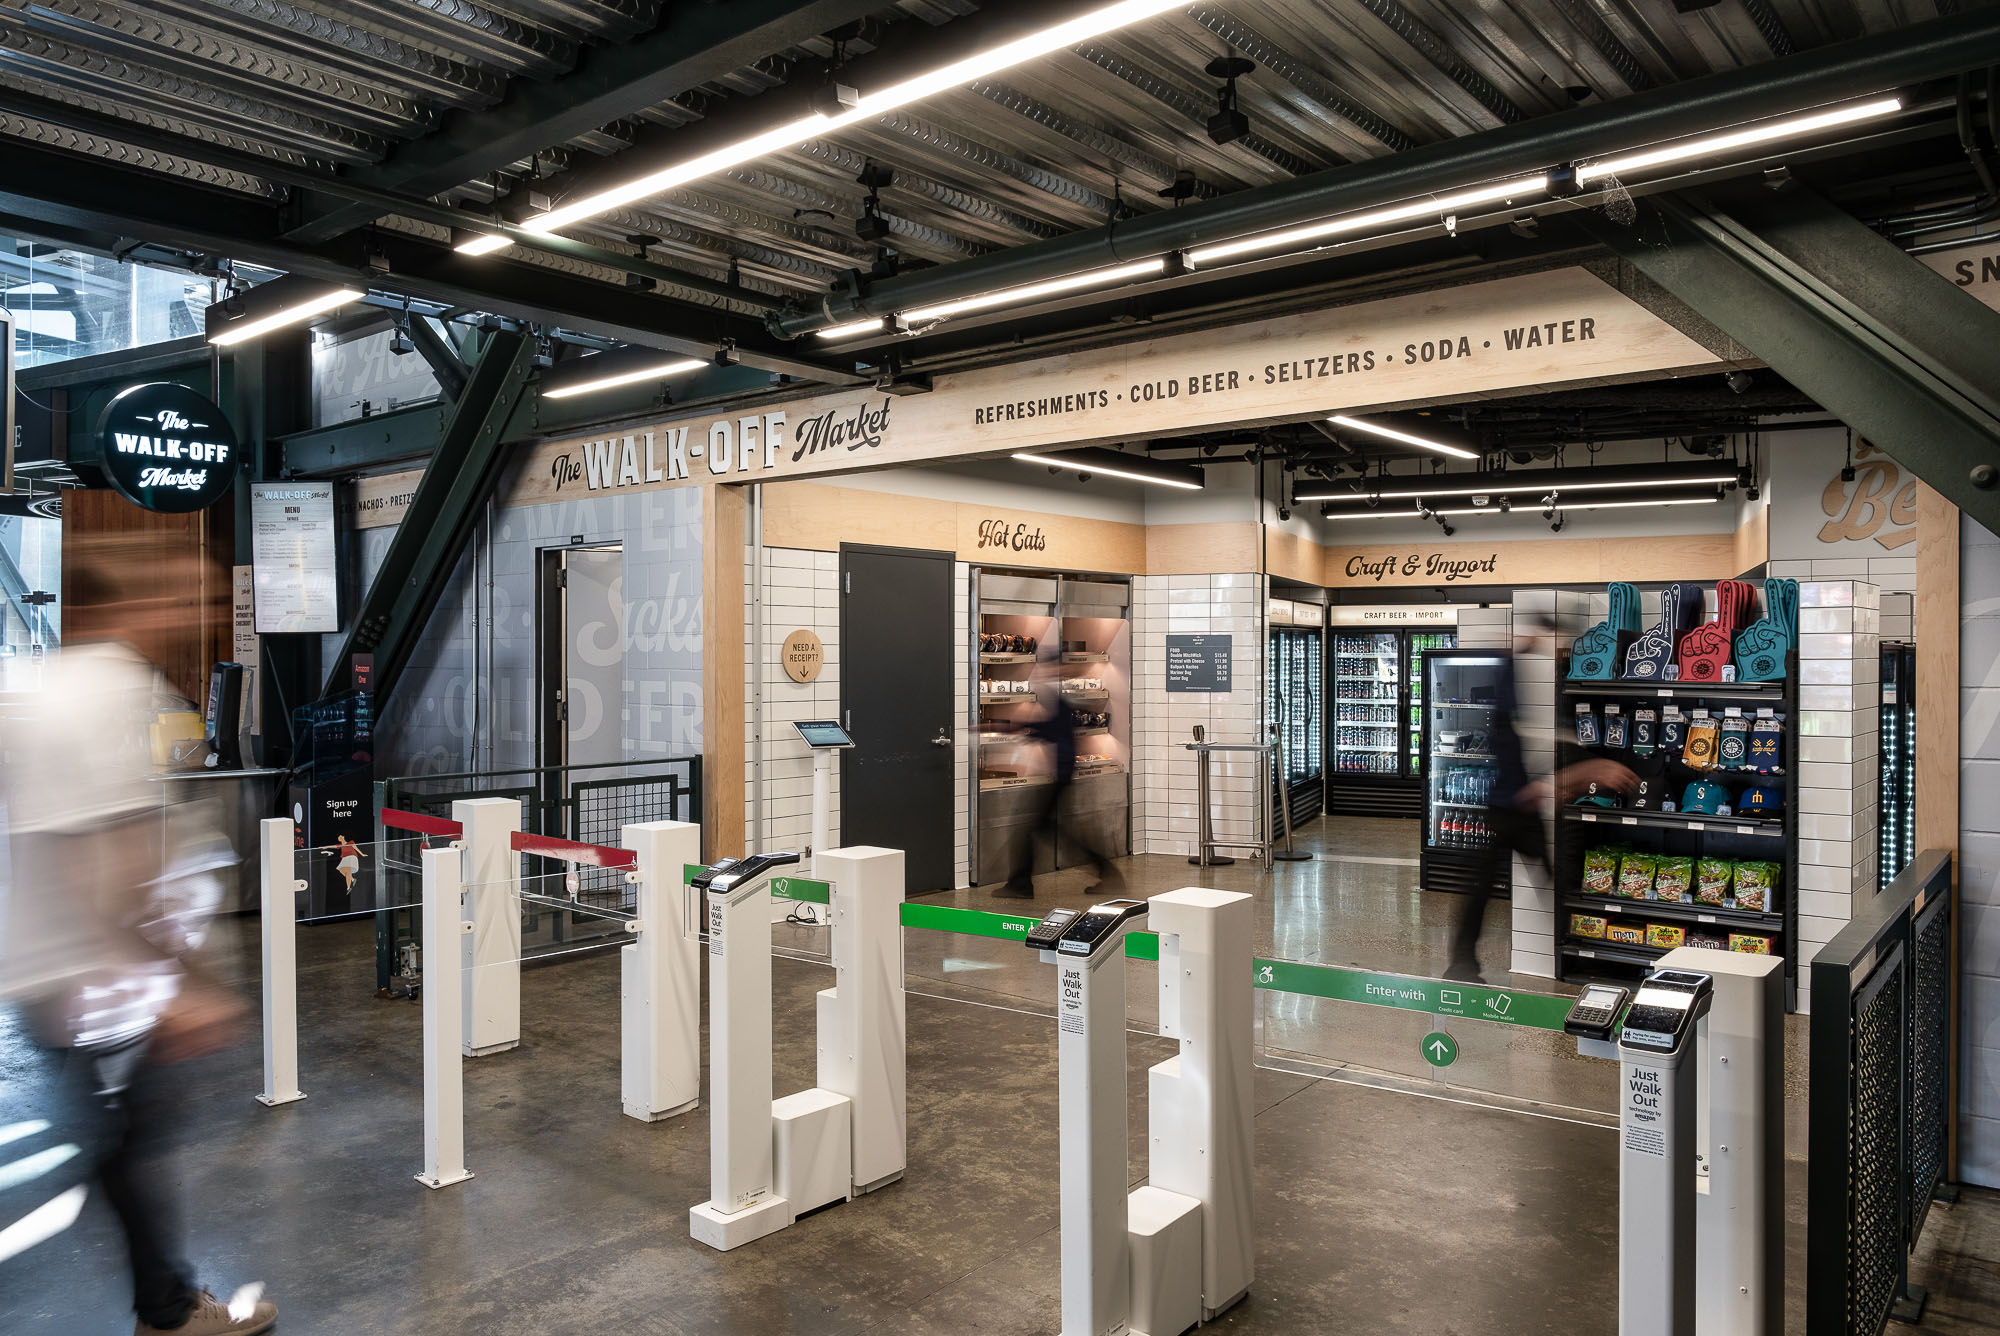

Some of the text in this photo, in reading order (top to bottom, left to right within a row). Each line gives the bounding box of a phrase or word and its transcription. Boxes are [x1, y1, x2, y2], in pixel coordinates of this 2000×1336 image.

[1503, 317, 1596, 351] WATER
[1404, 336, 1472, 365] SODA
[1264, 350, 1375, 385] SELTZERS
[1130, 370, 1240, 403] COLD BEER
[975, 390, 1108, 425] REFRESHMENTS
[158, 410, 190, 431] The
[114, 432, 229, 463] WALK-OFF
[551, 396, 892, 492] The WALK-OFF Market
[138, 467, 207, 491] Market
[284, 506, 301, 514] MENU
[977, 519, 1046, 552] Hot Eats
[1345, 553, 1498, 582] Craft & Import
[1415, 611, 1444, 619] IMPORT
[792, 643, 815, 651] NEED A
[789, 653, 819, 663] RECEIPT?
[326, 800, 358, 809] Sign up
[333, 810, 352, 818] here
[711, 904, 722, 912] Just
[710, 911, 723, 920] Walk
[711, 919, 721, 927] Out
[1002, 922, 1025, 931] ENTER
[1064, 969, 1080, 980] Just
[1062, 978, 1082, 990] Walk
[1064, 988, 1080, 999] Out
[1365, 983, 1426, 1001] Enter with
[1482, 1012, 1499, 1020] Mobile
[1632, 1067, 1659, 1082] Just
[1629, 1080, 1662, 1096] Walk
[1633, 1093, 1658, 1108] Out
[1629, 1106, 1655, 1116] technology
[1635, 1113, 1656, 1121] amazon
